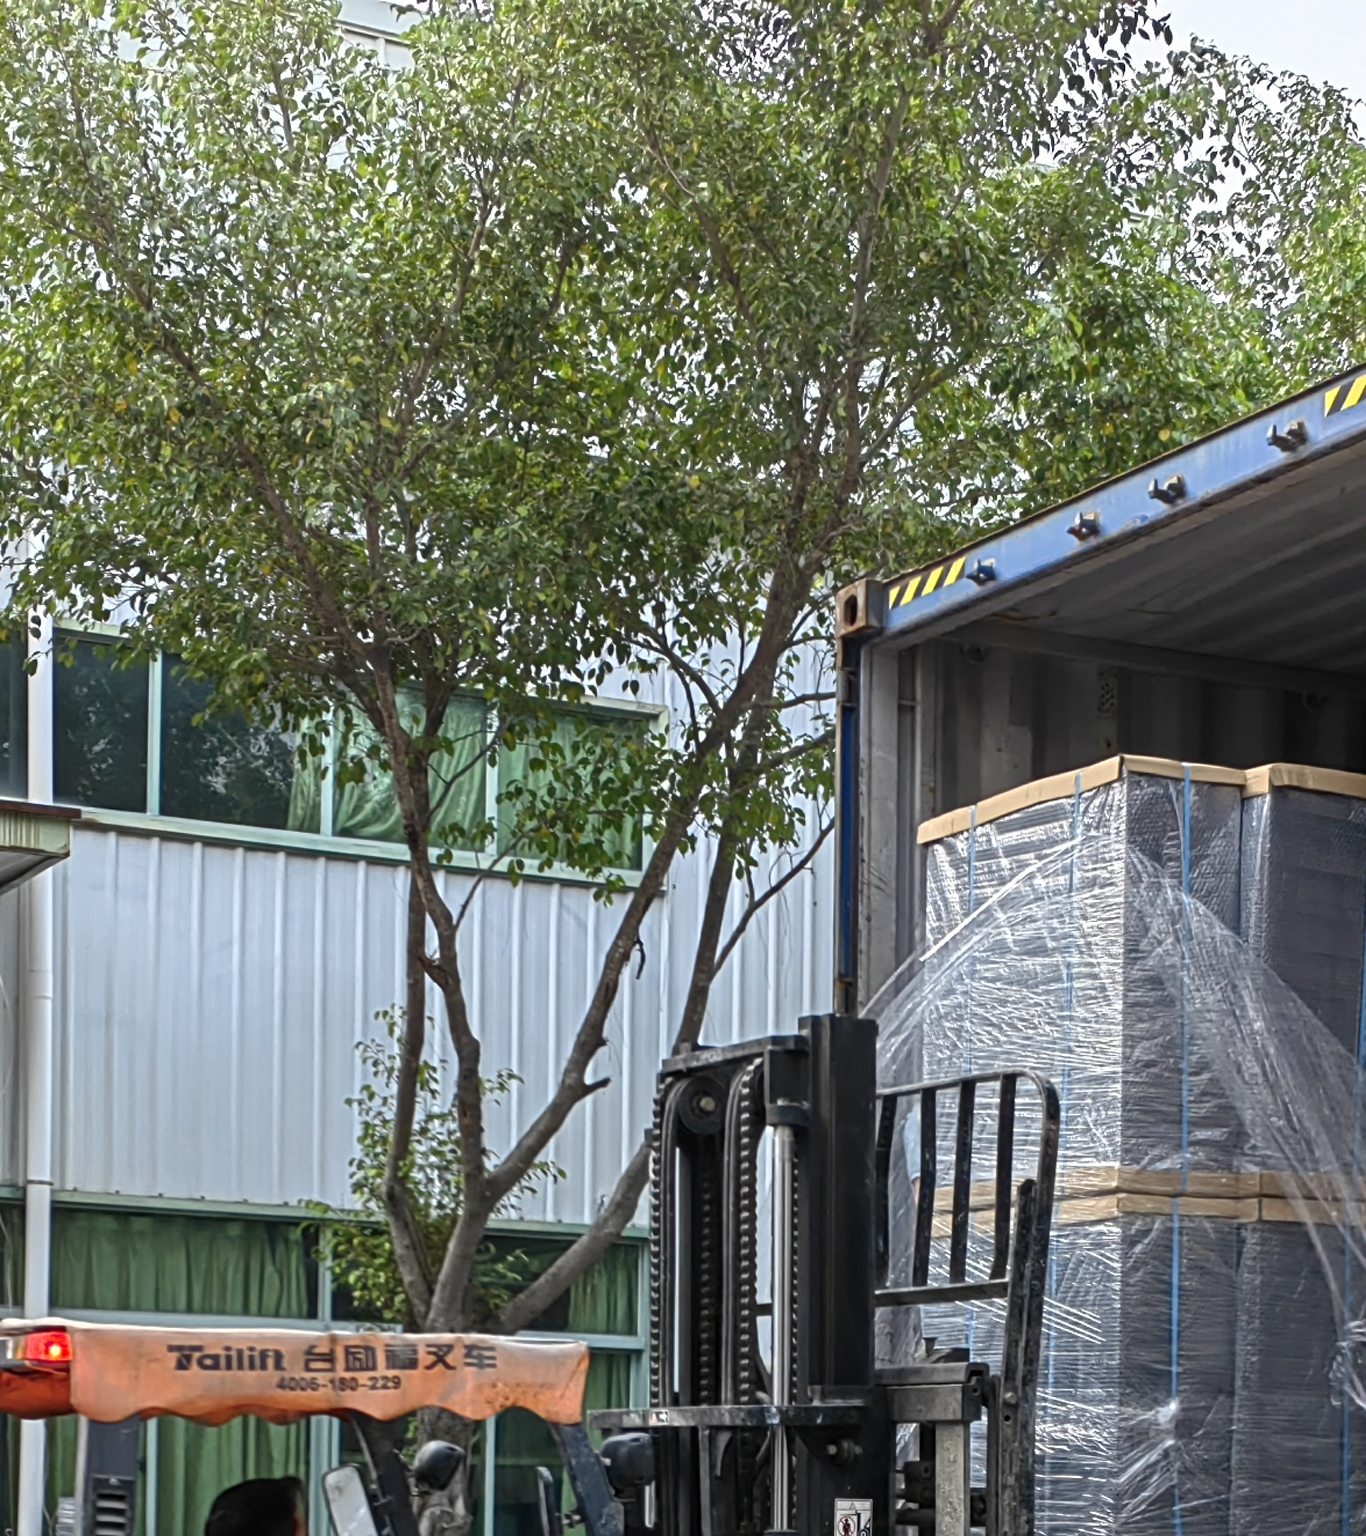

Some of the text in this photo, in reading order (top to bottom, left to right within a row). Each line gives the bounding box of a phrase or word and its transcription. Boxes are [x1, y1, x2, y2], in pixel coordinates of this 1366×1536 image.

[167, 1344, 287, 1372] Tailift
[303, 1344, 497, 1373] 台励福叉车
